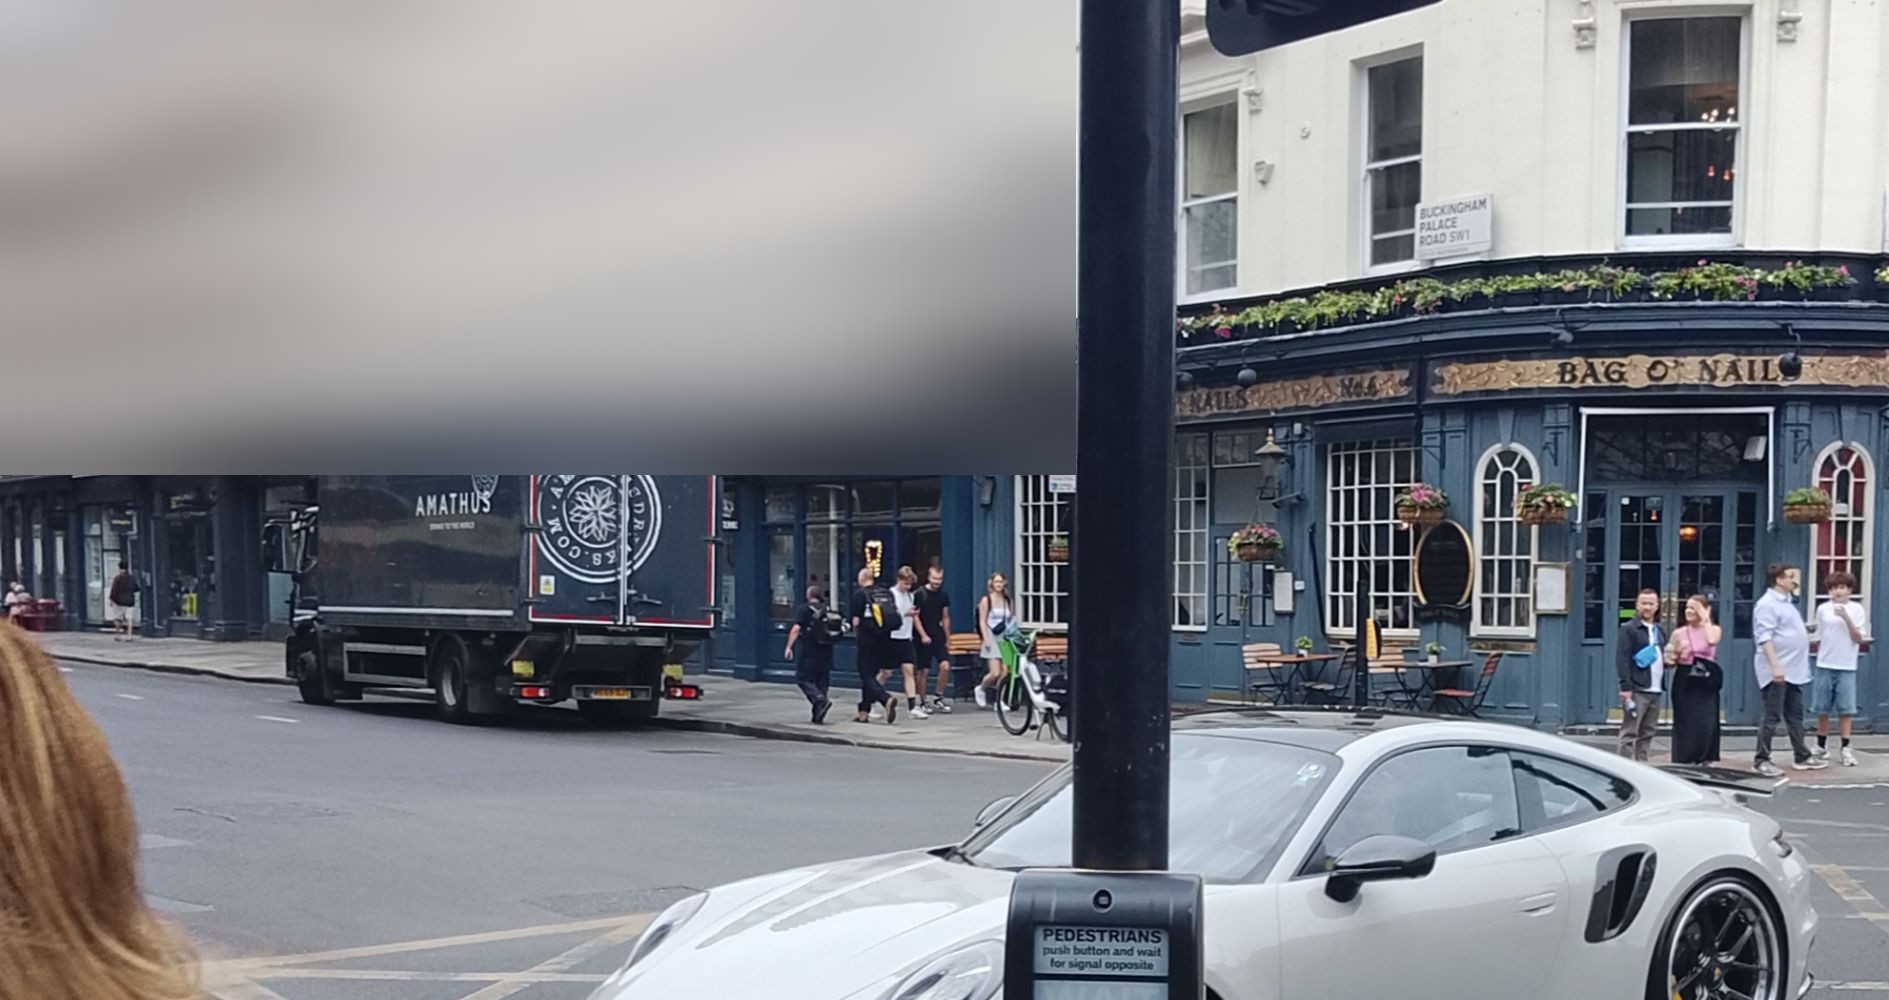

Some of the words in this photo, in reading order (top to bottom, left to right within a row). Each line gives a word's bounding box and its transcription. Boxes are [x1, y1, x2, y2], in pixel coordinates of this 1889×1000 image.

[1419, 198, 1487, 219] BUCKINGHAM
[1419, 217, 1458, 233] PALACE
[1419, 232, 1447, 247] ROAD
[1448, 229, 1471, 243] SW1
[1558, 359, 1629, 384] BAG
[415, 491, 491, 517] AMATHUS
[1043, 928, 1162, 944] PEDESTRIANS
[1043, 945, 1070, 956] push
[1073, 945, 1110, 956] button
[1113, 946, 1134, 957] and
[1137, 947, 1161, 957] wait
[1050, 957, 1065, 969] for
[1068, 958, 1102, 970] signal
[1105, 959, 1154, 971] opposite
